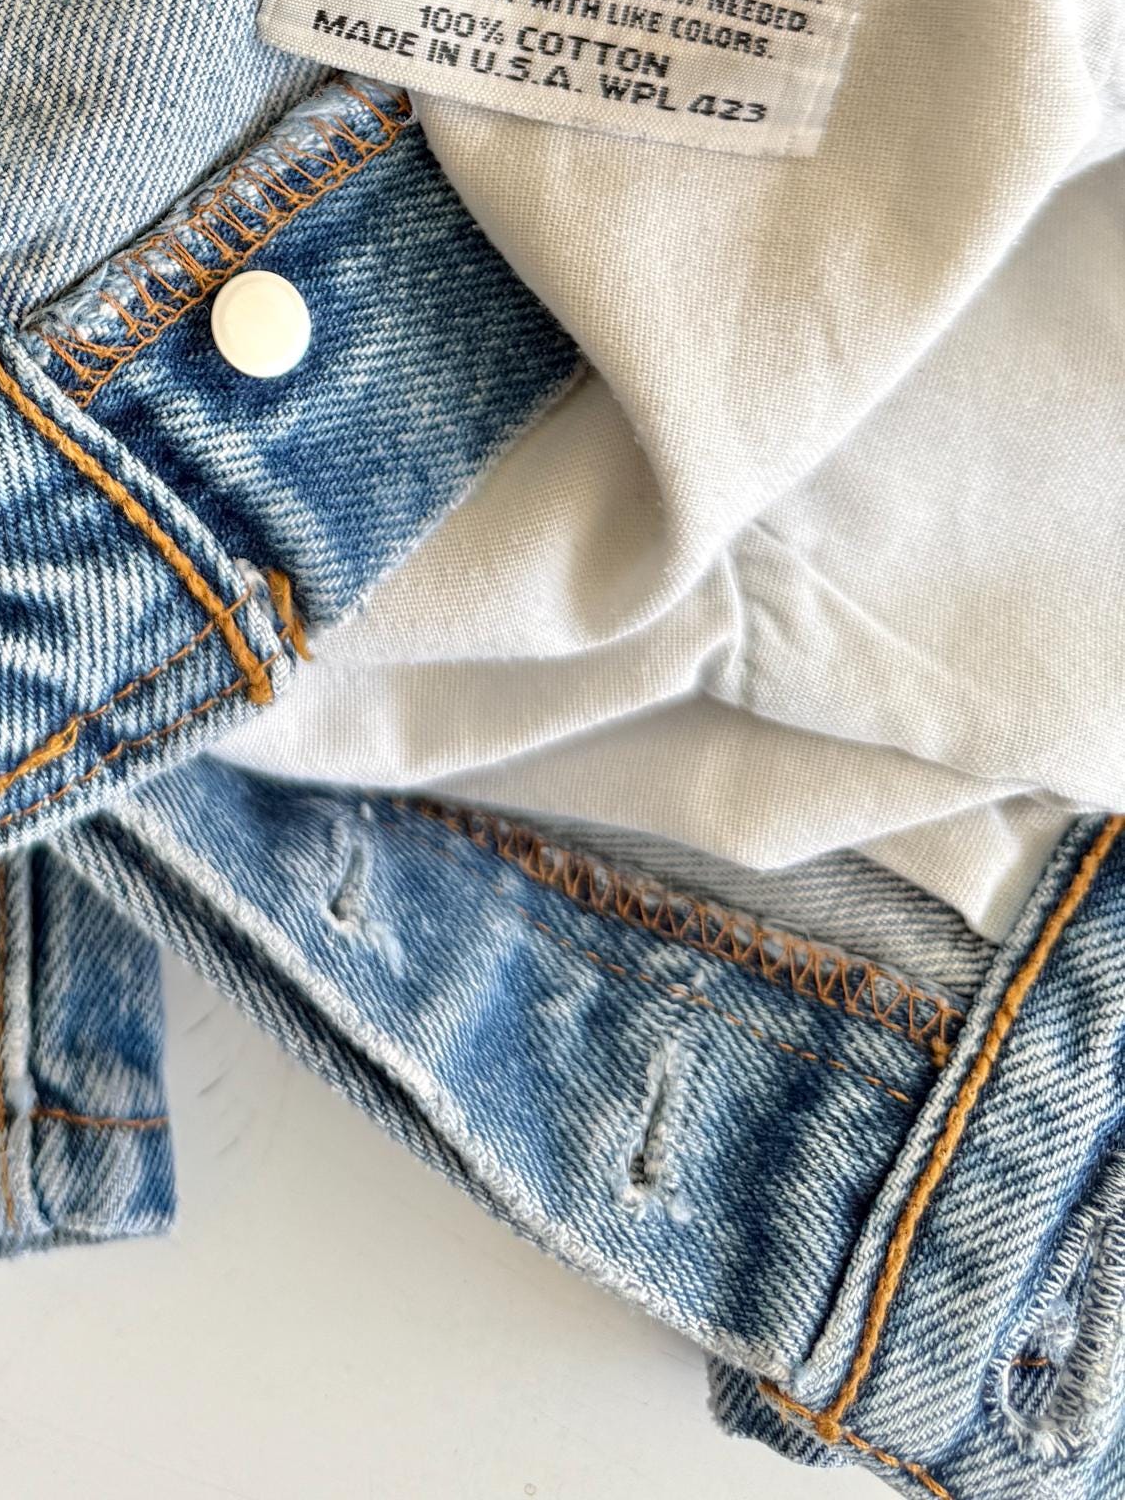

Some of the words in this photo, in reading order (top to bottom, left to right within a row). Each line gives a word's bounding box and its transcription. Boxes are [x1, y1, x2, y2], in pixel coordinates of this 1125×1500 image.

[312, 9, 419, 58] MADE
[426, 38, 460, 67] IN
[470, 48, 582, 94] U.S.A.
[599, 73, 676, 111] WPL
[687, 93, 767, 122] 423
[418, 5, 505, 45] 100%
[515, 26, 670, 78] COTTON
[606, 3, 663, 34] LIKE
[671, 16, 773, 60] COLORS.
